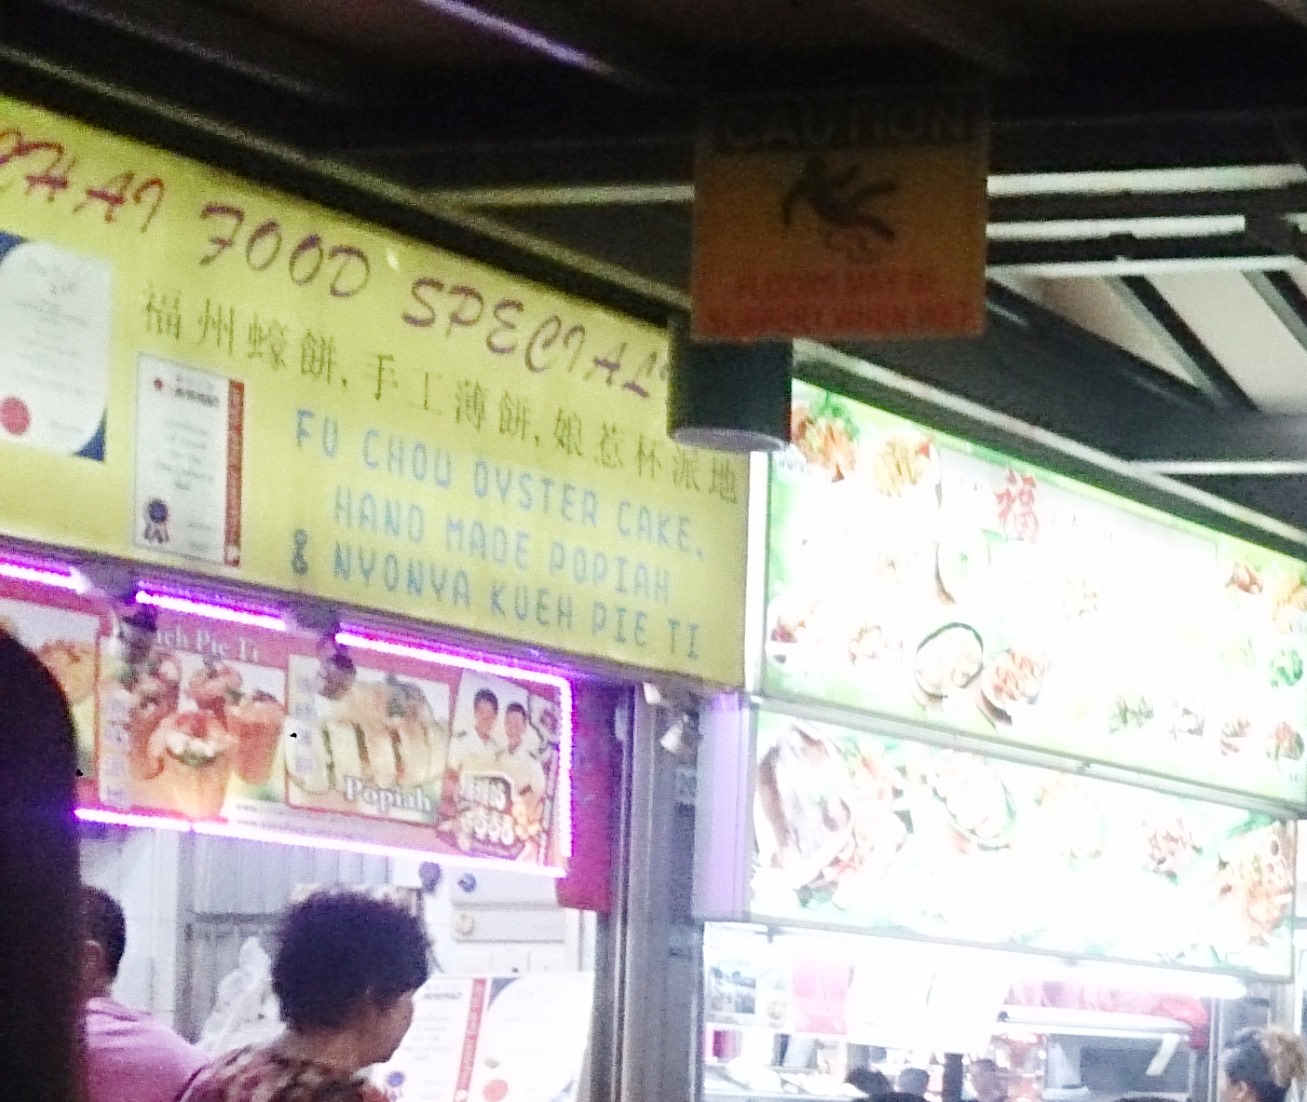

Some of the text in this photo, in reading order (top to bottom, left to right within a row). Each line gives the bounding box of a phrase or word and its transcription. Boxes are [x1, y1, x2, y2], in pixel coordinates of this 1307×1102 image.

[200, 201, 371, 298] FOOD
[402, 277, 667, 398] SPECIAL
[295, 407, 339, 457] FU
[363, 428, 453, 488] CHOU
[473, 458, 598, 529] OYSTER
[334, 486, 671, 603] HAND MADE POPIAH
[334, 541, 471, 607] NYONYA
[490, 583, 573, 631] KUEH
[592, 600, 648, 648] PIE
[667, 618, 701, 661] TI
[343, 774, 432, 815] Popiah
